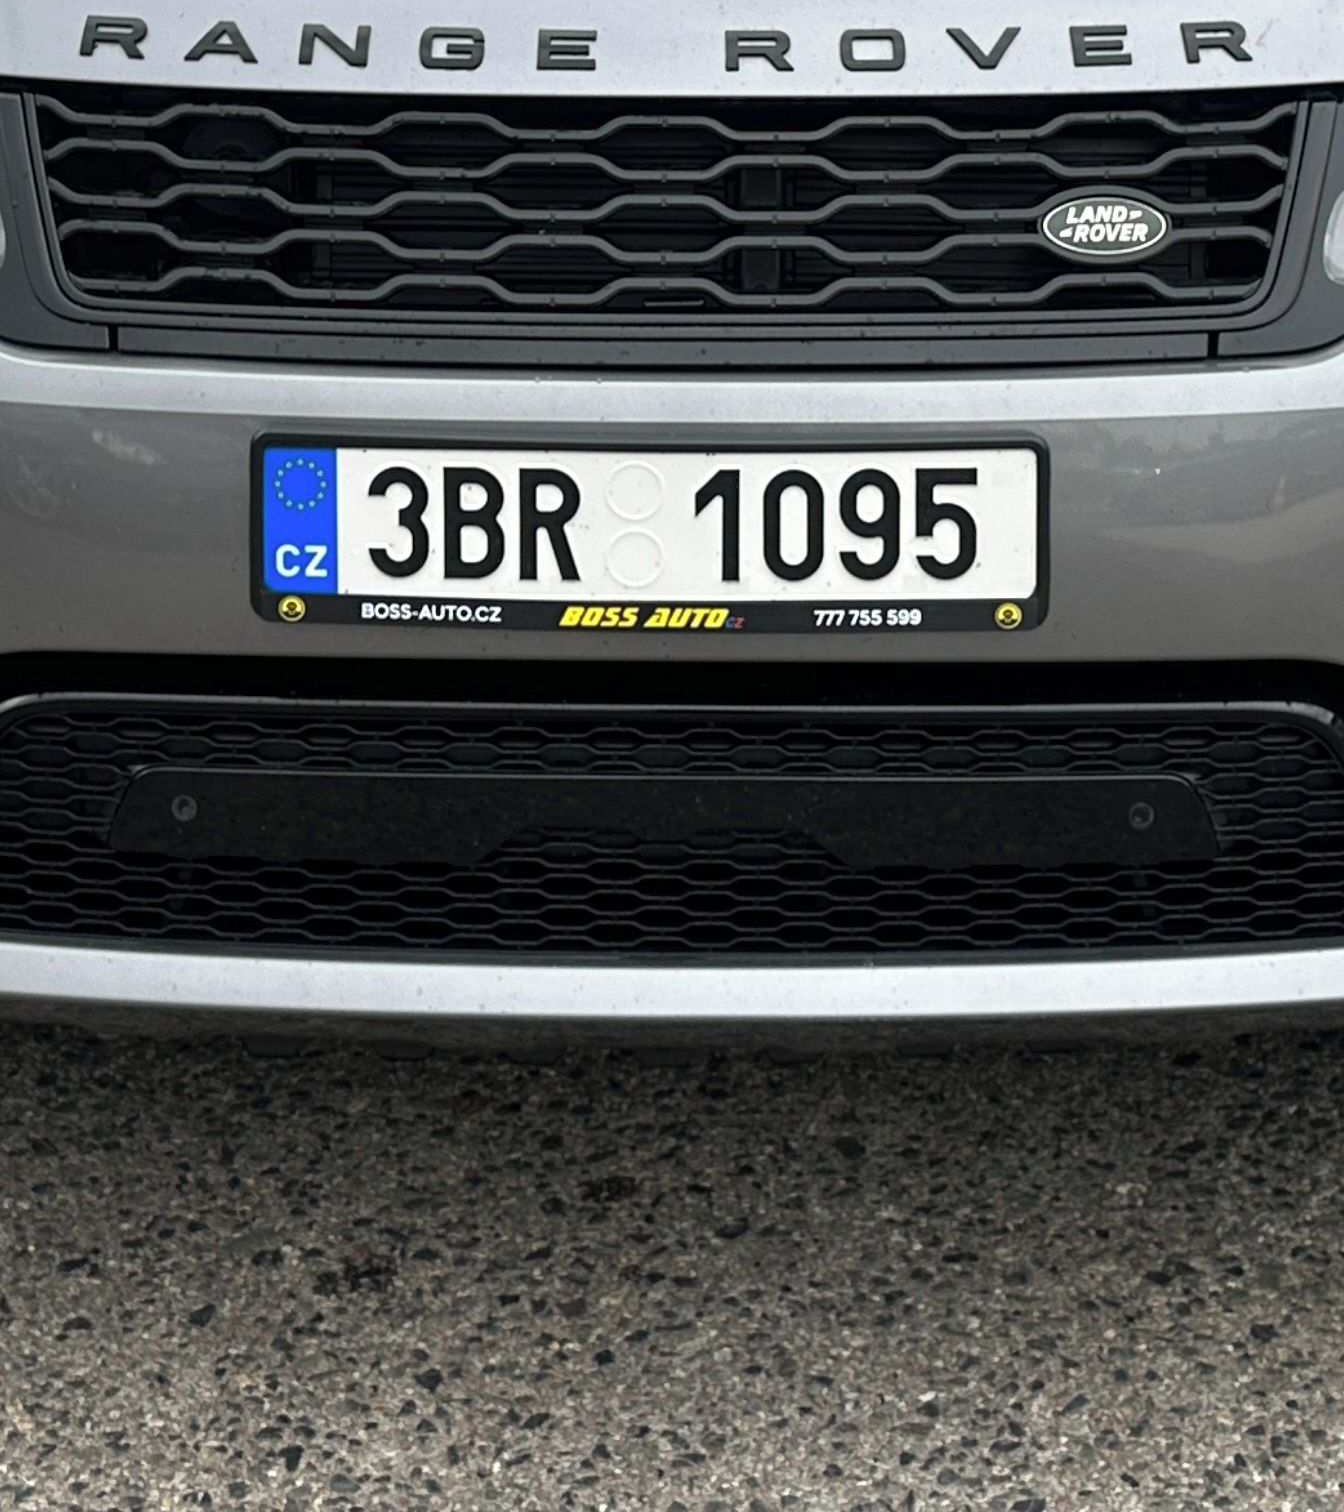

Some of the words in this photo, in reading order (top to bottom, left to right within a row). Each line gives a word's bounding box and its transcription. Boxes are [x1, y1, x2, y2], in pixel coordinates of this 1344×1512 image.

[78, 14, 599, 71] RANGE
[723, 19, 1253, 71] ROVER
[1066, 206, 1129, 225] LAND
[1072, 223, 1150, 244] ROVER
[367, 465, 582, 582] 3BR
[694, 466, 978, 582] 1095
[274, 543, 329, 578] CZ
[360, 602, 502, 623] BOSS-AUTO.CZ
[559, 606, 640, 628] BOSS
[644, 606, 730, 629] AUTO
[813, 608, 844, 627] 777
[848, 609, 884, 627] 755
[886, 609, 923, 627] 599
